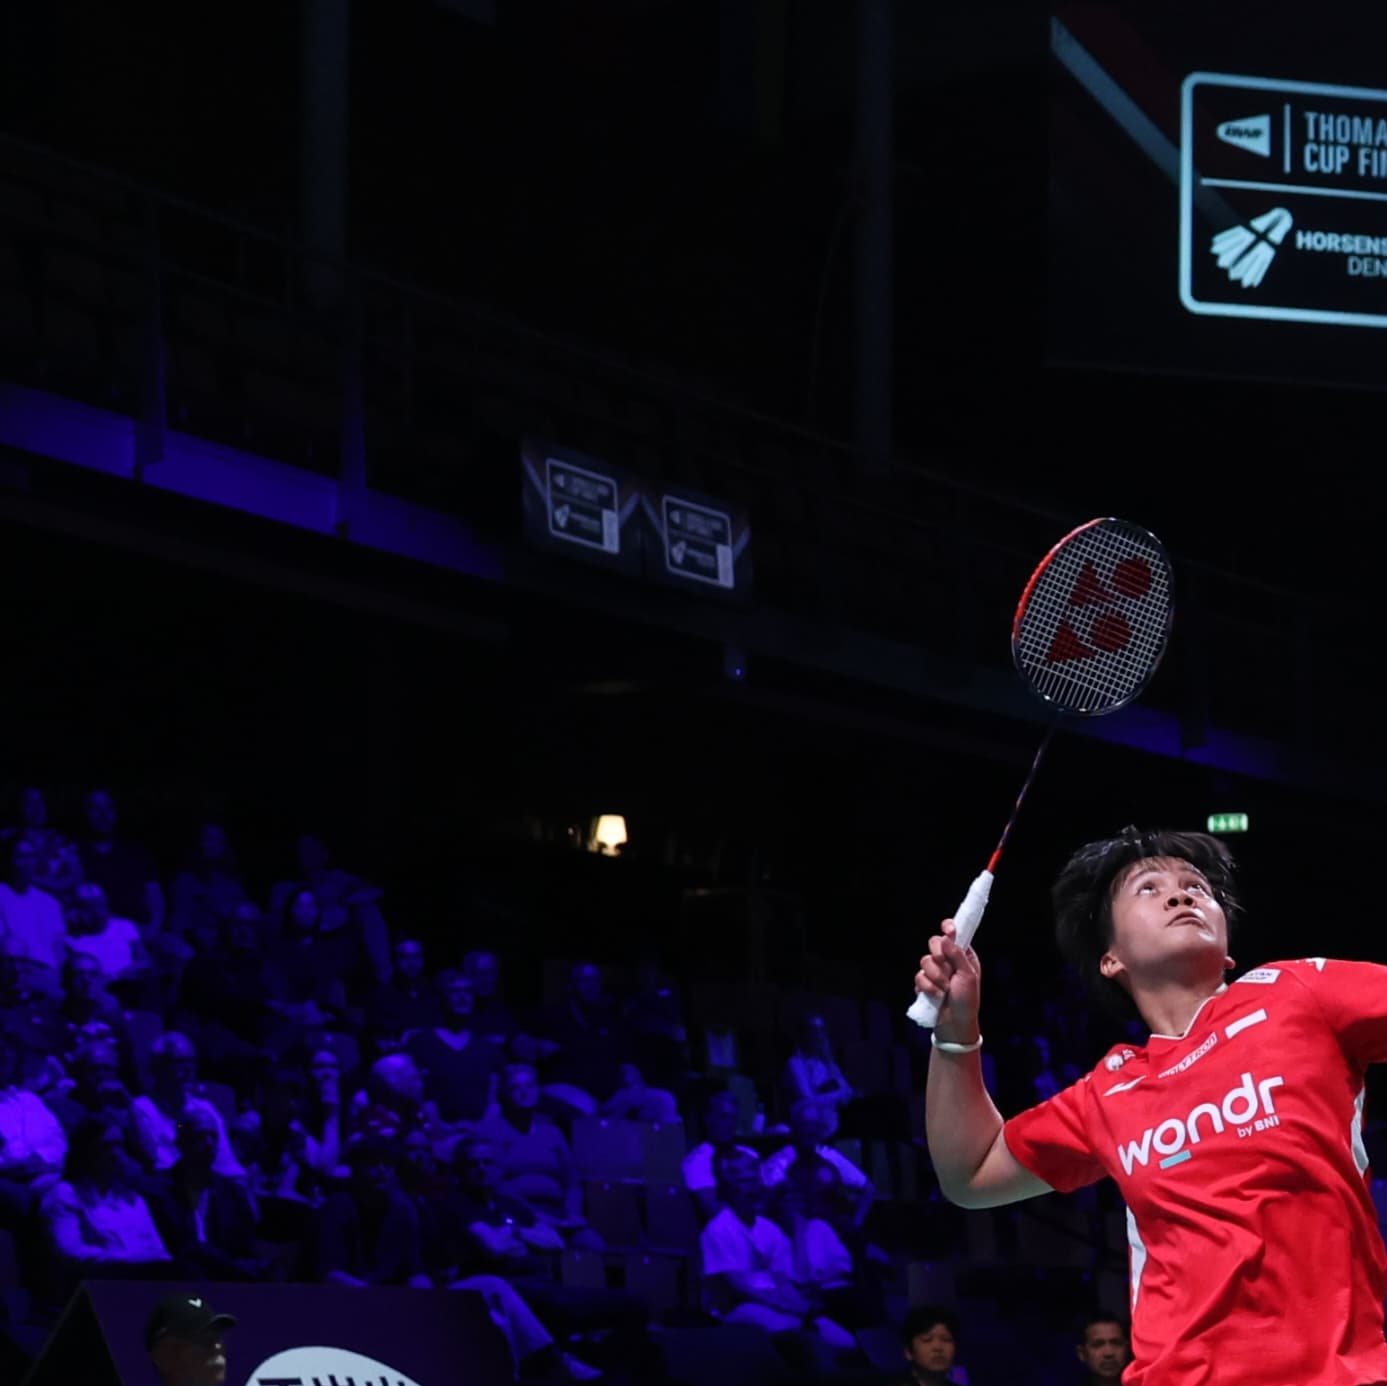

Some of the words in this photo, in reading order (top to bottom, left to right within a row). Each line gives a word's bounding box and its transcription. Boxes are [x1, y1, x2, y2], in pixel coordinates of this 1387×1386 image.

[1304, 142, 1350, 174] CUP
[1117, 1071, 1284, 1177] wondr
[1236, 1126, 1253, 1139] by
[1254, 1114, 1280, 1133] BNI
